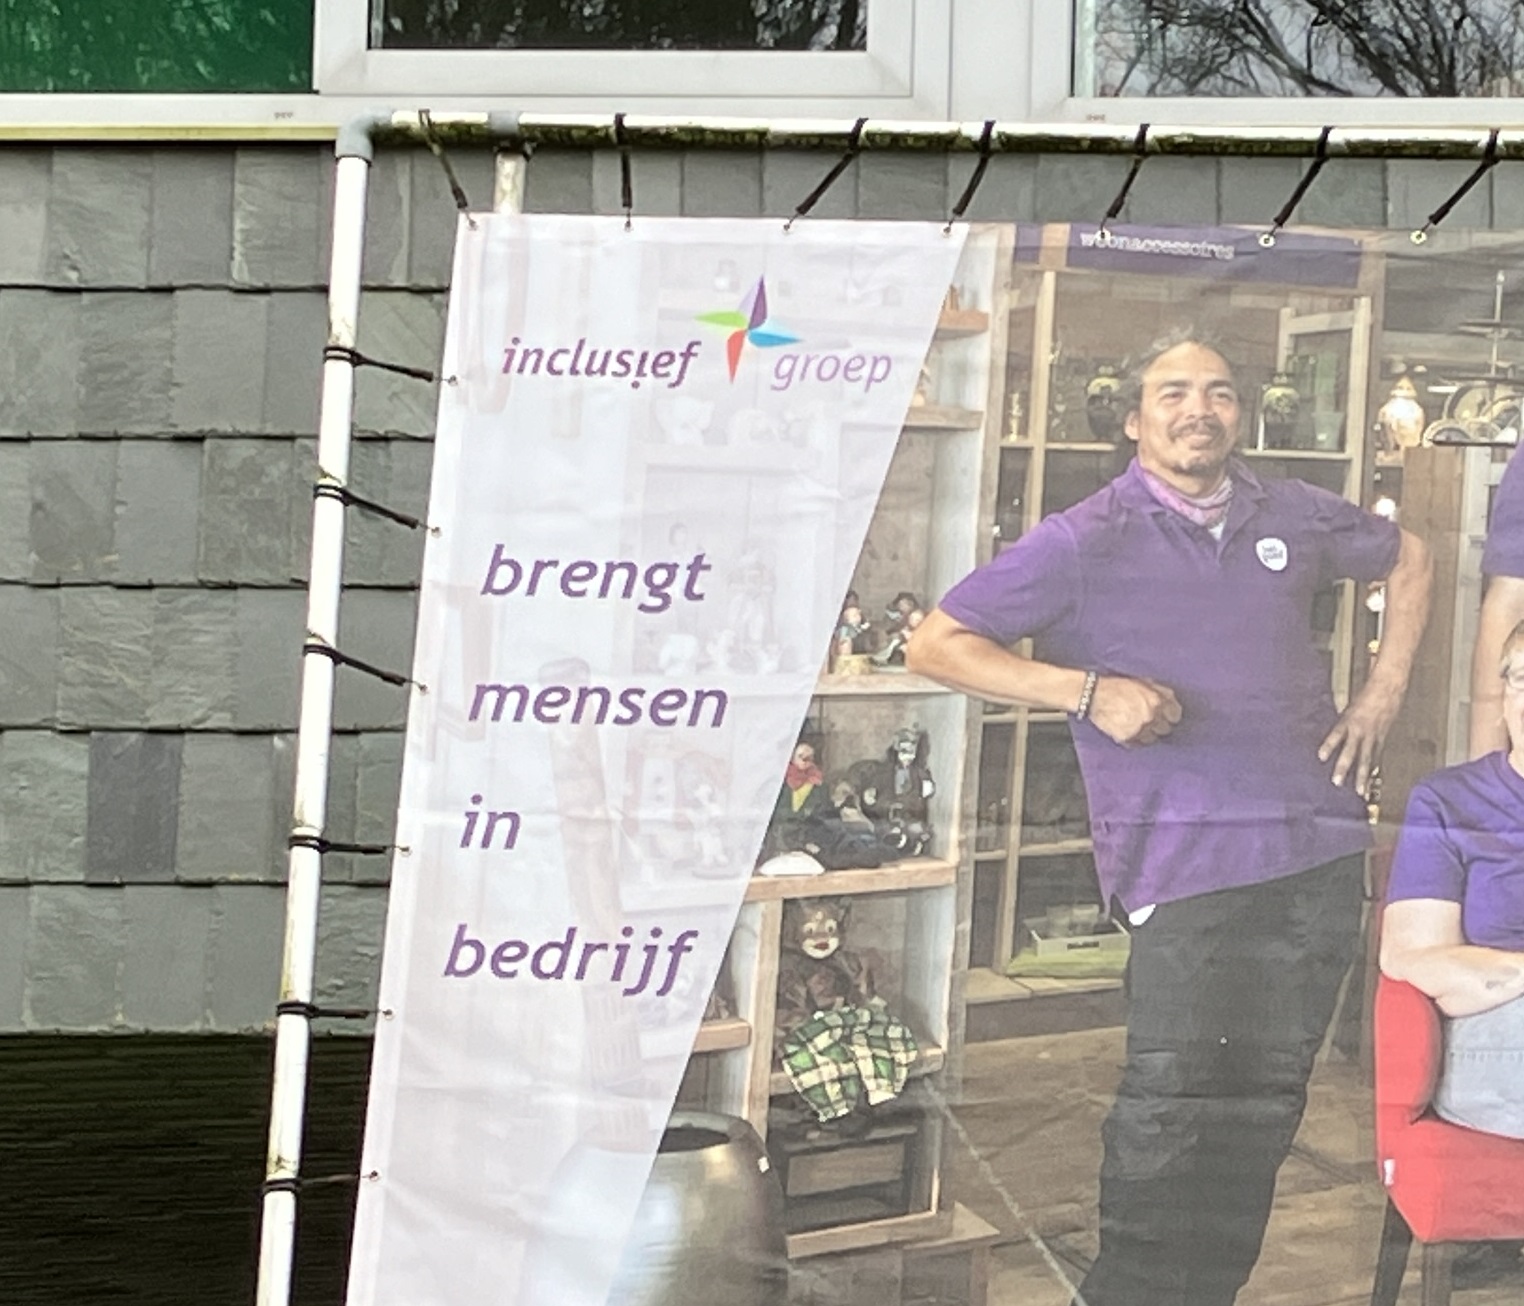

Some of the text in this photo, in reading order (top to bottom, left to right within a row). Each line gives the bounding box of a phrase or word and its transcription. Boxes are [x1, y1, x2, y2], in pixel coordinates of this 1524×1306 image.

[501, 337, 893, 393] inclusief groep
[480, 544, 712, 614] brengt
[468, 683, 728, 728] mensen
[459, 795, 521, 850] in
[443, 924, 699, 997] bedrijf
